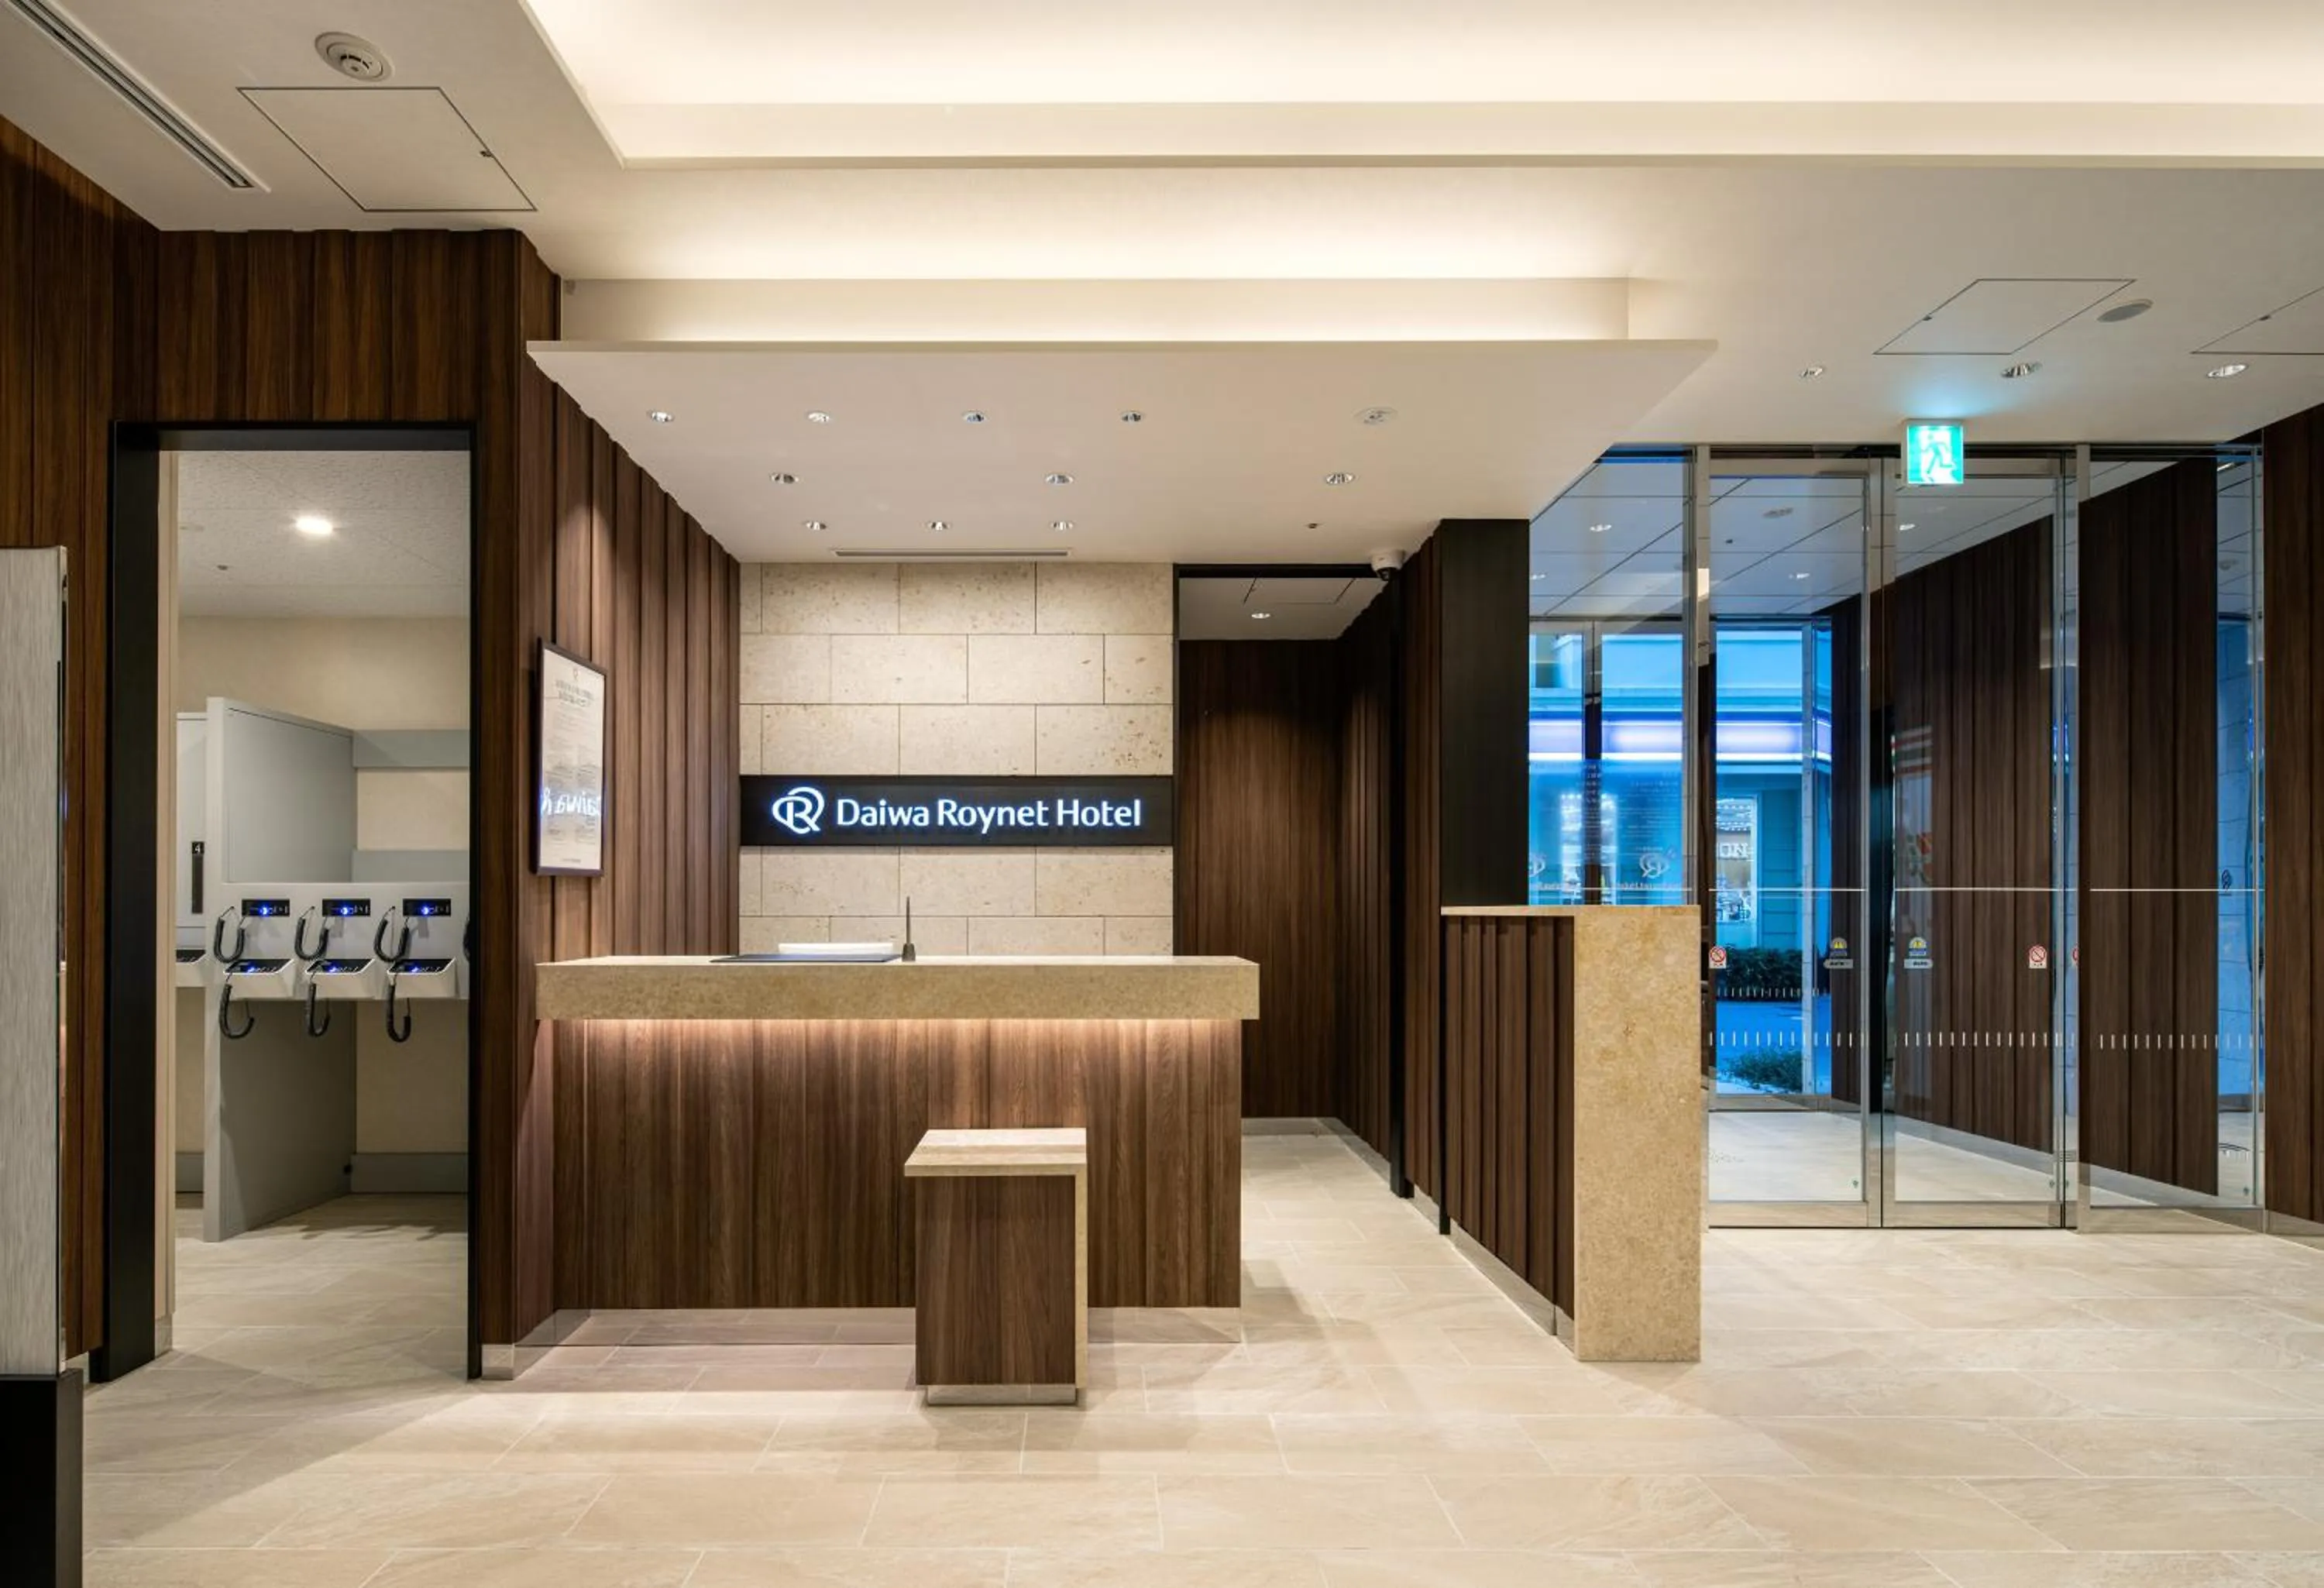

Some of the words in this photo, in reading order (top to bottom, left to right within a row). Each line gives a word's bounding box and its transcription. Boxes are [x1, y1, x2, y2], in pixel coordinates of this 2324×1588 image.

[837, 799, 930, 827] Daiwa
[937, 799, 1050, 834] Roynet
[1057, 799, 1141, 827] Hotel
